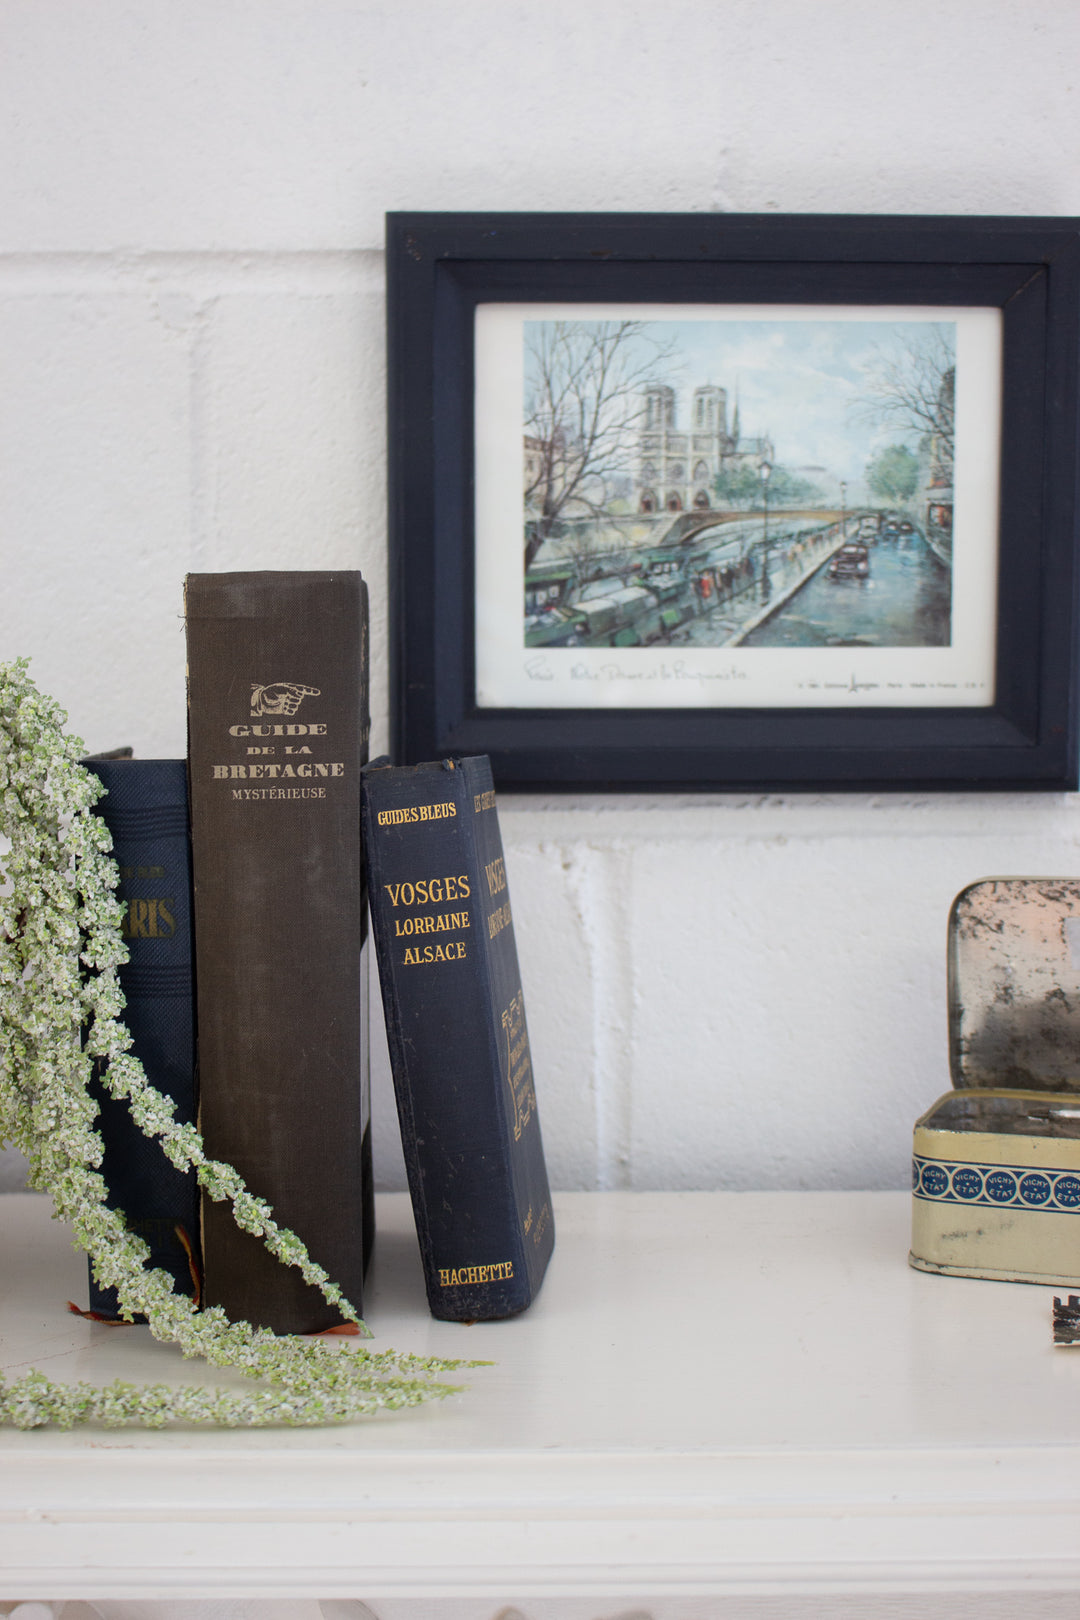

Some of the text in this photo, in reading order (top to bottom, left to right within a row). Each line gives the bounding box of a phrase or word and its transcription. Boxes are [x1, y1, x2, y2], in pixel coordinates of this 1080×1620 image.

[228, 723, 328, 737] GUIDE
[246, 745, 313, 755] DE LA
[211, 762, 345, 779] BRETAGNE
[231, 785, 327, 800] MYSTÉRIEUSE
[377, 807, 420, 826] GUIDES
[420, 801, 457, 822] BLEUS
[384, 875, 471, 907] VOSGES
[120, 898, 177, 938] RIS
[394, 911, 471, 937] LORRAINE
[403, 941, 467, 965] ALSACE
[923, 1170, 946, 1179] VICHY
[954, 1173, 980, 1183] VICHY
[988, 1176, 1014, 1185] VICHY
[923, 1181, 945, 1191] ETAT
[955, 1184, 980, 1194] ETAT
[1022, 1178, 1048, 1188] VICHY
[989, 1188, 1013, 1198] ETAT
[1023, 1191, 1048, 1200] ETAT
[438, 1261, 514, 1287] HACHETTE
